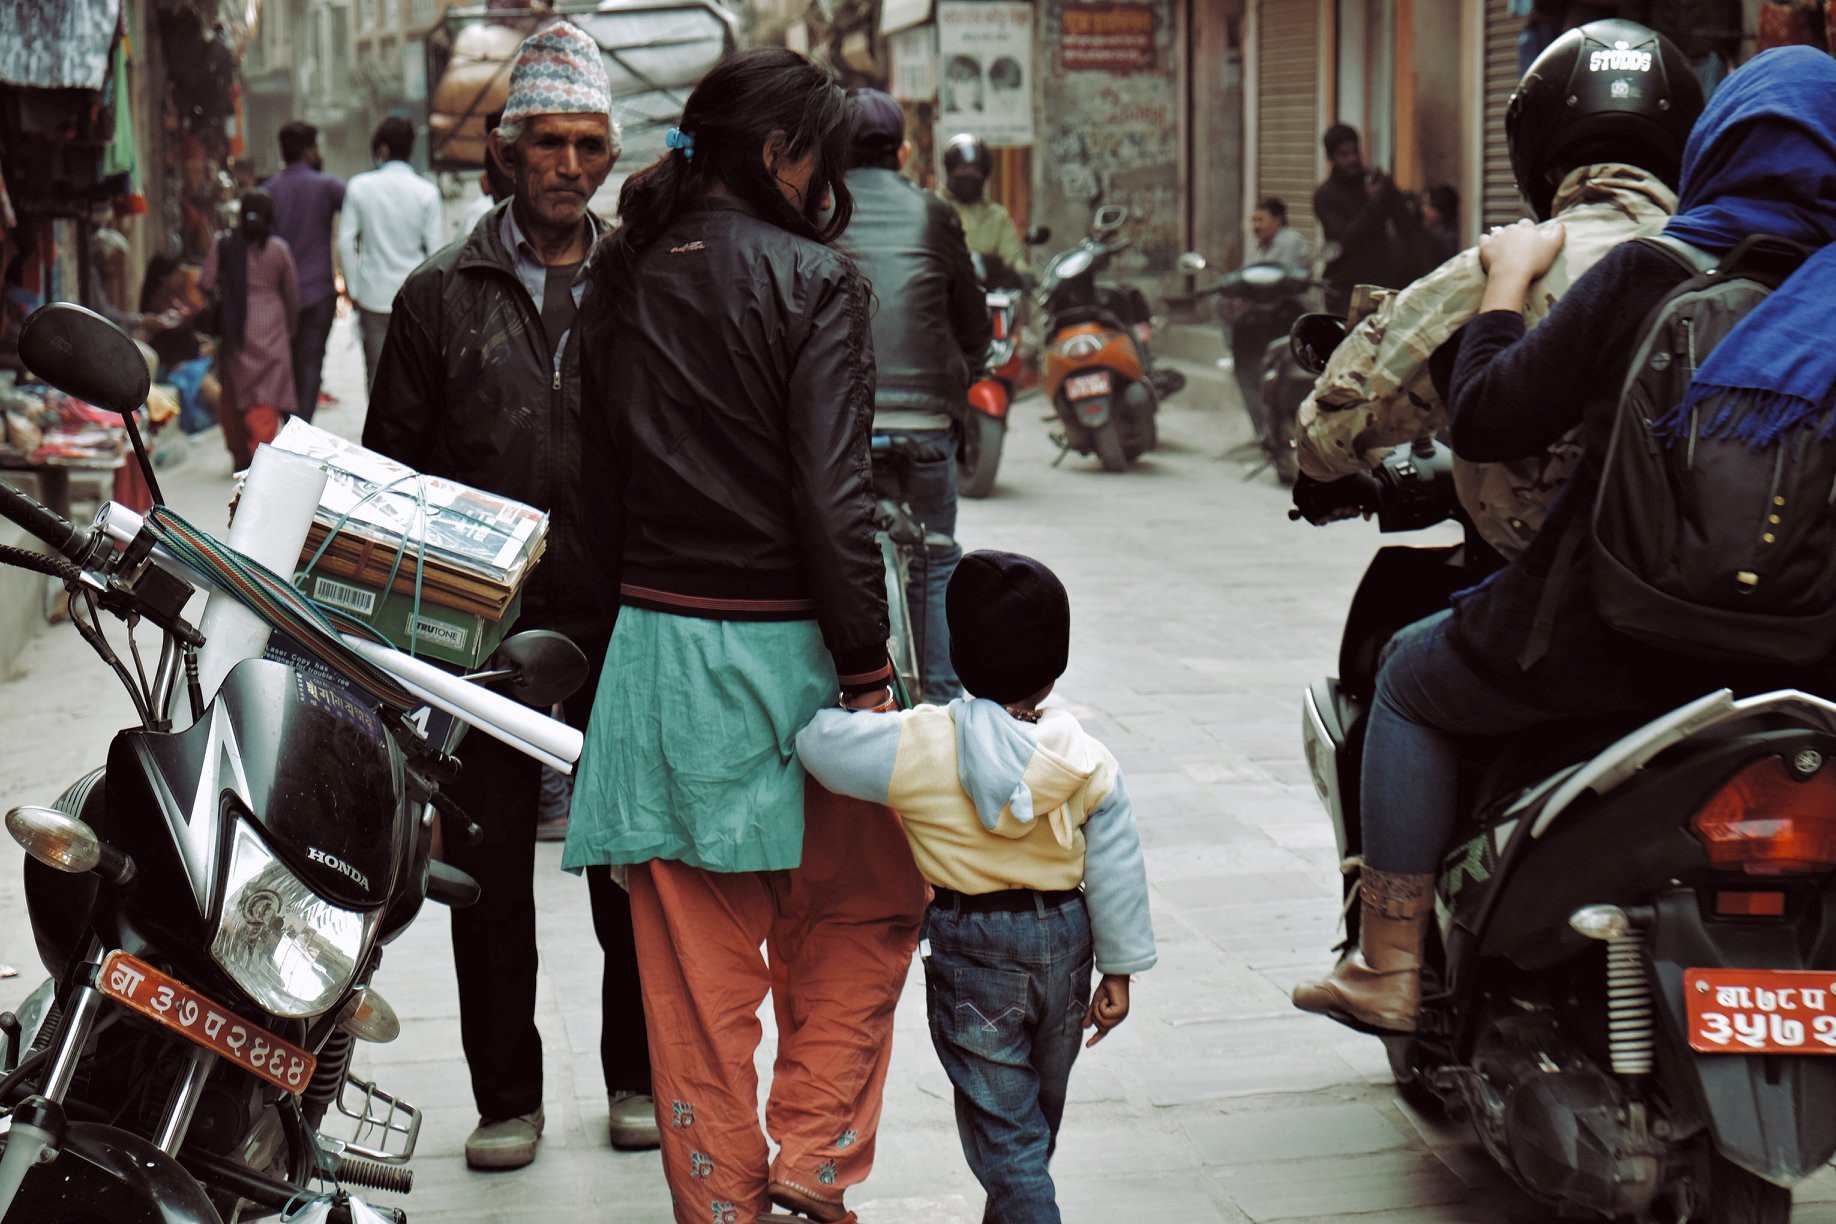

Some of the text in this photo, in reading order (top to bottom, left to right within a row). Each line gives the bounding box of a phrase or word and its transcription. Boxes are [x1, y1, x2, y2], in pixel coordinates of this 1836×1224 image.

[1589, 49, 1652, 72] STUDDS
[307, 846, 371, 892] HONDA
[111, 962, 146, 999] बा
